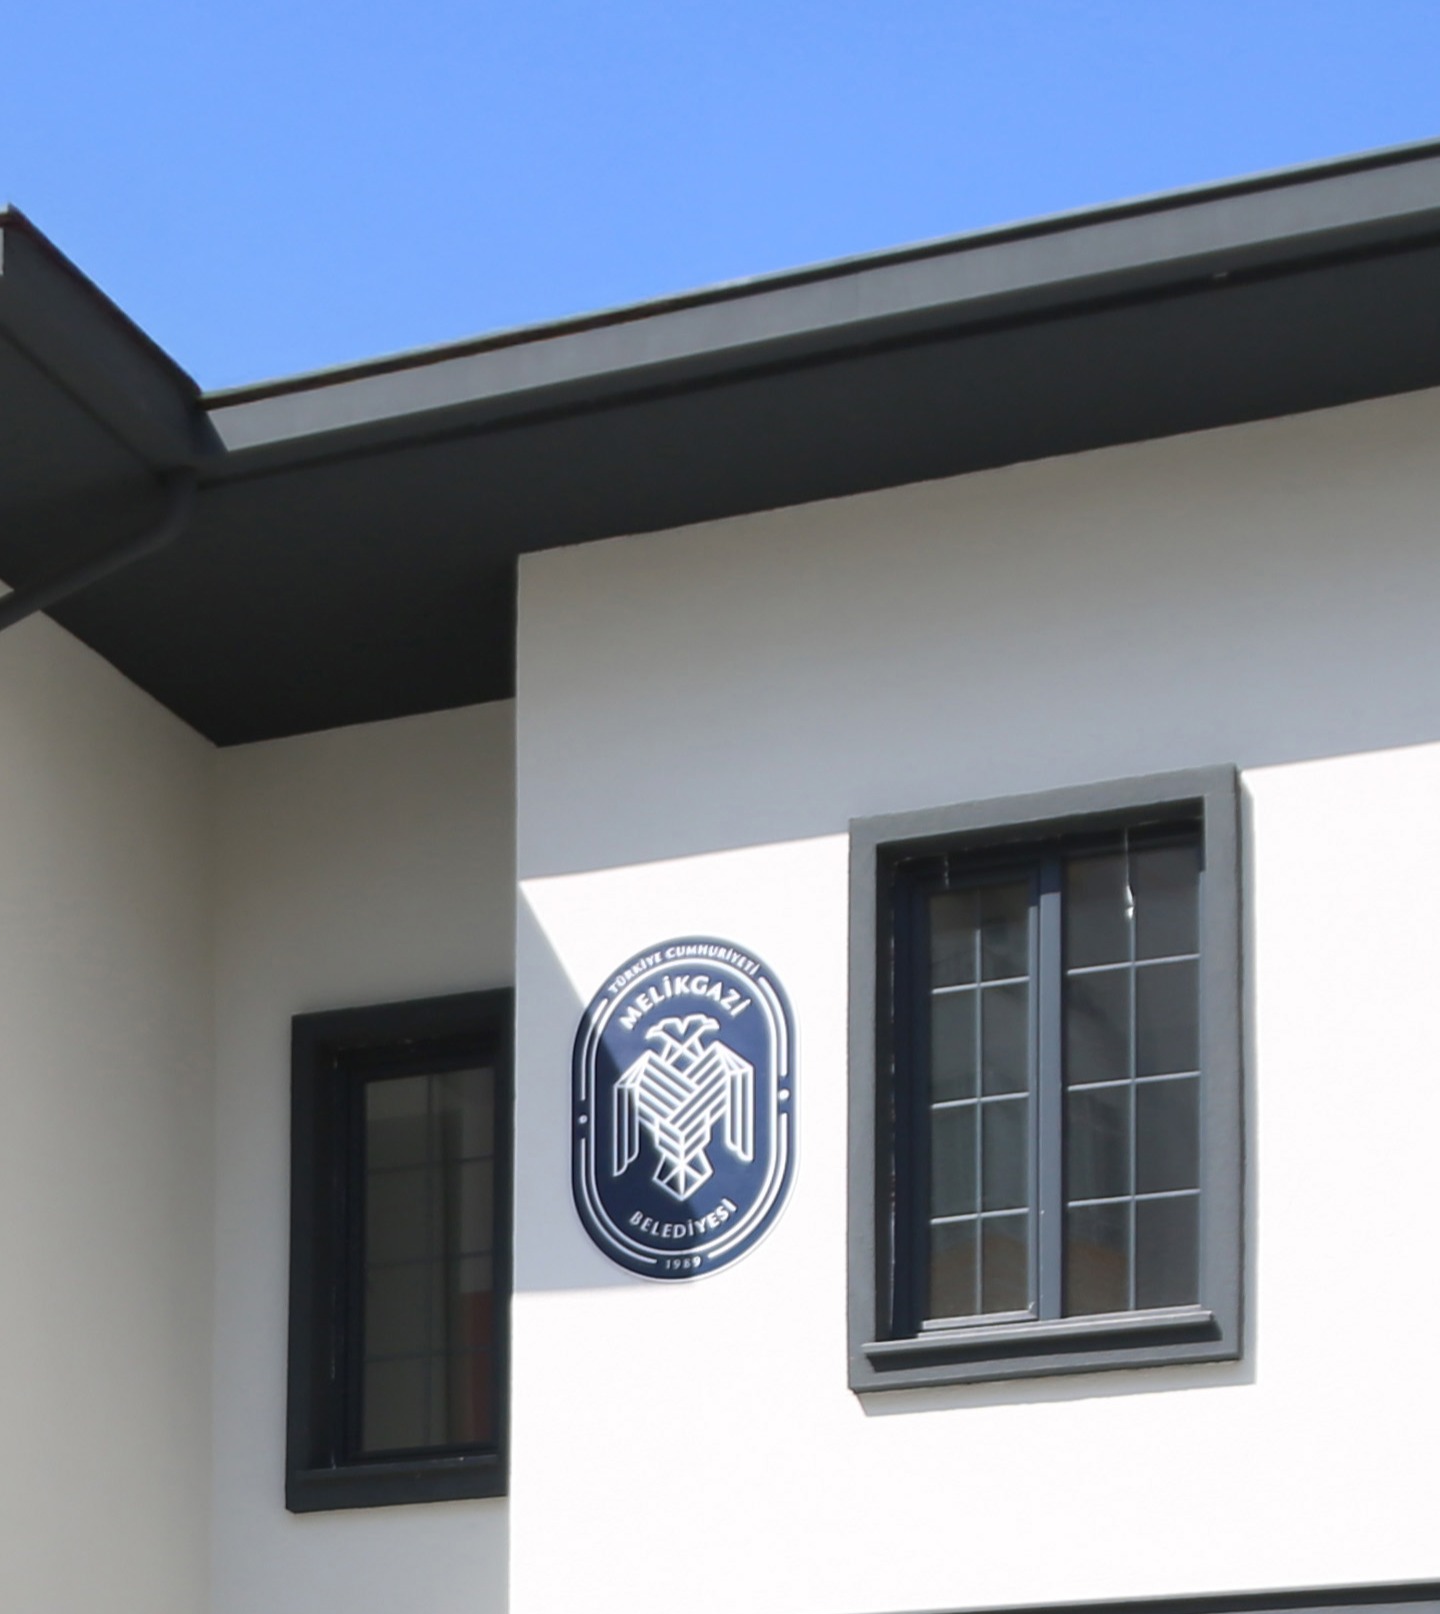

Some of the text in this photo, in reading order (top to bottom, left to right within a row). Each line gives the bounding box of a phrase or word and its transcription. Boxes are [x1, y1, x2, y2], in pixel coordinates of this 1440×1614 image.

[608, 944, 761, 994] TÜRKİYE CUMHURİYETİ
[619, 974, 752, 1031] MELİKGAZİ
[629, 1198, 738, 1239] BELEDİYESİ
